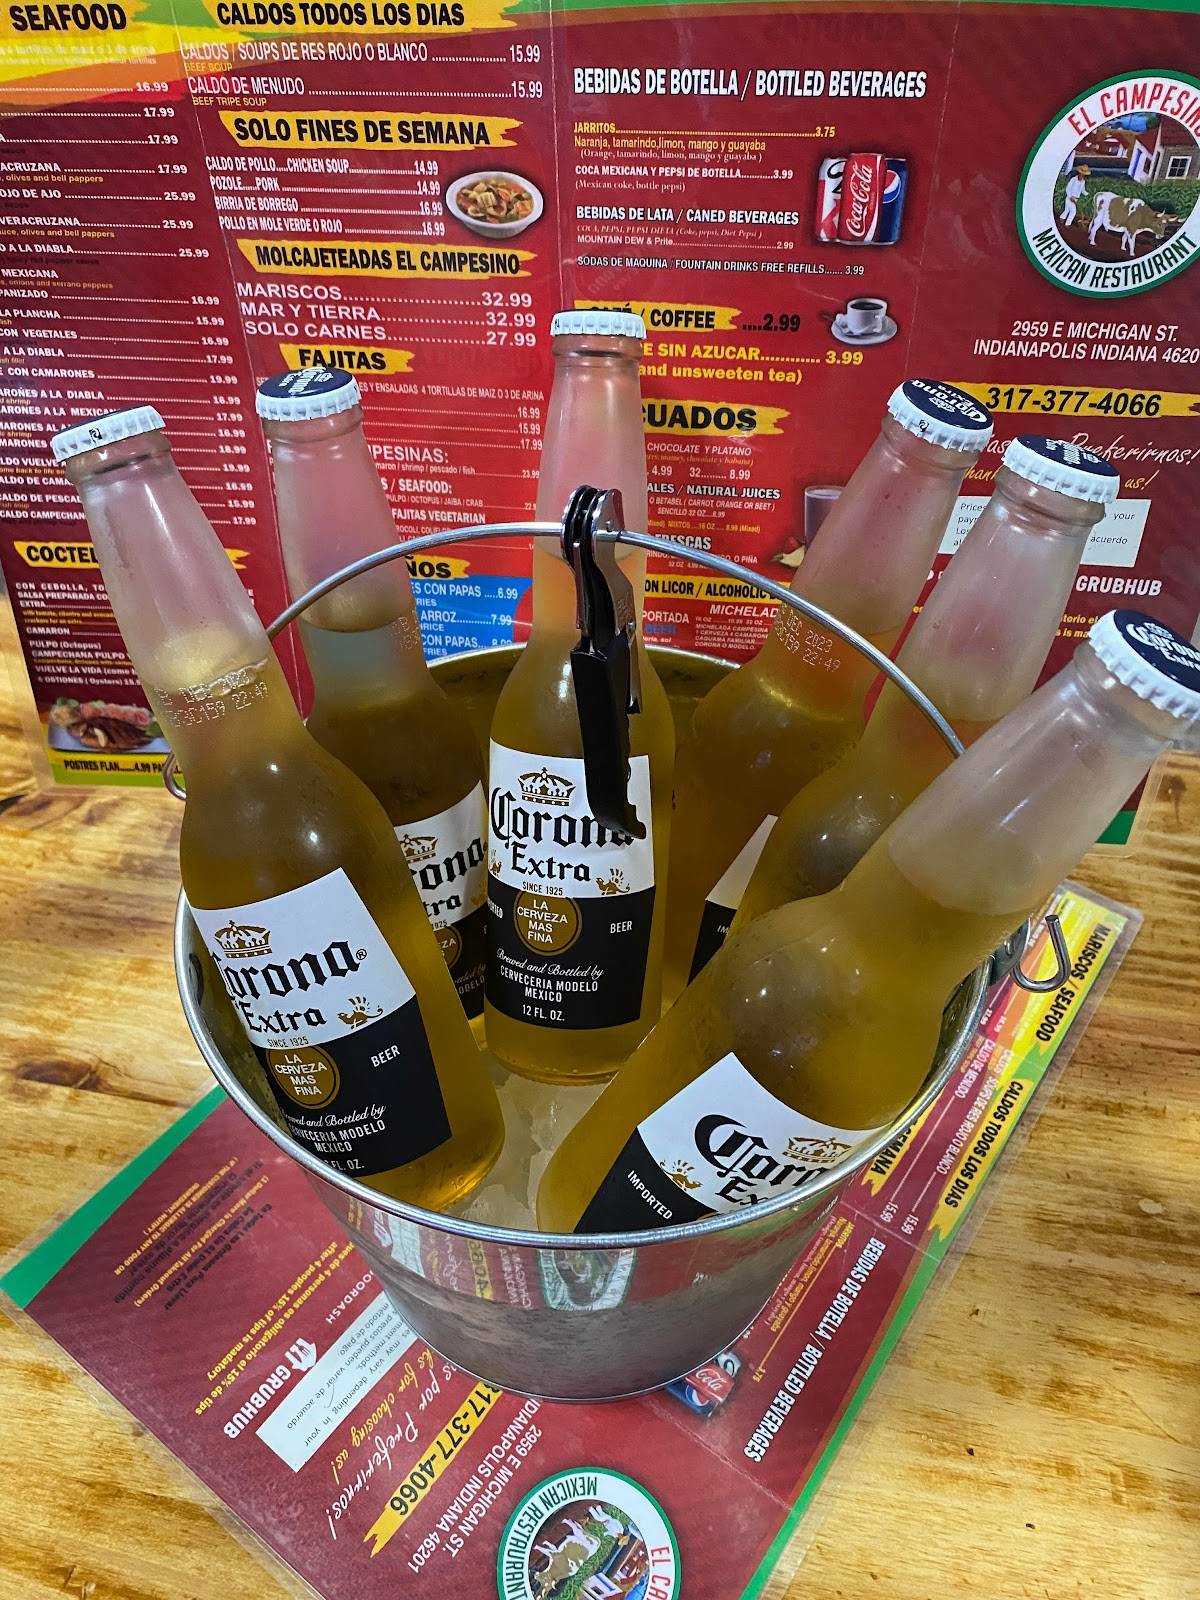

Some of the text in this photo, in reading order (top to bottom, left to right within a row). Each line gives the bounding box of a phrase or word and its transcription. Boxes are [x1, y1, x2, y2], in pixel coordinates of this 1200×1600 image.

[9, 3, 126, 31] SEAFOOD
[217, 3, 464, 26] CALDOS TODOS LOS DIAS
[181, 43, 541, 63] CALDOS SOUPS DE RES ROJO O BLANCO 15.99
[188, 76, 543, 98] CALDO DE MENUDO 15.99
[574, 68, 927, 98] BEBIDAS DE BOTELLA BOTTLED BEVERAGES
[193, 97, 267, 107] BEEF TRIPE SOUP
[234, 118, 491, 144] SOLO FINES DE SEMANA
[1068, 114, 1097, 136] EL
[688, 139, 766, 152] mango guayaba
[205, 156, 247, 171] CALDO DE
[575, 165, 700, 178] COCA MEXICANA PEPSI DE
[164, 192, 195, 201] 25.99
[214, 196, 299, 212] BIRRIA DE BORREGO
[219, 216, 342, 233] POLLO EN MOLE VERDE ROJO
[576, 206, 799, 225] BEBIDAS DE LATA CANED BEVERAGES
[577, 235, 644, 245] MOUNTAIN DEW
[179, 249, 209, 258] 25.99
[256, 245, 520, 274] MOLCAJETEADAS EL CAMPESINO
[1033, 227, 1197, 288] MEXICAN RESTAURANT
[577, 256, 864, 275] SODAS FOUNTAIN DRINKS FREE 3.99
[237, 282, 532, 308] MARISCOS 32.99
[241, 302, 536, 327] MAR Y TIERRA 32.99
[650, 308, 716, 329] COFFEE
[23, 329, 77, 339] VEGETALES
[245, 322, 536, 346] SOLO CARNES 27.99
[1012, 321, 1178, 342] 2959 E MICHIGAN ST.
[299, 349, 387, 370] FAJITAS
[658, 344, 864, 365] SIN AZUCAR 3.99
[973, 339, 1158, 362] INDIANAPOLIS INDIANA
[8, 368, 95, 379] CON CAMARONES
[672, 366, 802, 385] unsweeten tea)
[375, 383, 545, 401] ENSALADAS TORTILLAS ARINA
[986, 387, 1162, 416] 317-377-4066
[647, 443, 752, 456] CHOCOLATE PLATANO
[730, 470, 750, 480] 8.99
[399, 479, 452, 494] SEAFOOD:
[687, 484, 780, 499] NATURAL JUICES
[392, 508, 486, 524] FAJITAS VEGETARIAN
[424, 582, 482, 597] CON PAPAS
[662, 581, 694, 596] LICOR
[1076, 576, 1162, 596] GRUBHUB
[421, 611, 457, 623] ARROZ
[511, 841, 591, 882] Extra
[522, 881, 563, 896] SINCE 1925
[533, 900, 548, 910] LA
[517, 907, 568, 923] CERVEZA
[528, 920, 553, 932] MAS
[610, 920, 632, 934] BEER
[527, 930, 553, 943] FINA
[501, 965, 598, 992] CERVECERIA MODELO
[527, 963, 604, 979] and Bottled by
[1036, 924, 1111, 1042] MARISCOS SEAFOOD
[525, 987, 562, 1002] MEXICO
[523, 1005, 532, 1016] 12
[371, 1045, 400, 1068] BEER
[275, 1062, 327, 1075] CERVEZA
[315, 1141, 352, 1153] MEXICO
[945, 1081, 1023, 1208] CALDOS TODOS LOS DIAS
[627, 1170, 674, 1220] IMPORTED
[854, 1236, 886, 1284] BEBIDAS
[841, 1282, 862, 1300] DE
[815, 1292, 853, 1340] BOTELLA
[788, 1344, 822, 1396] BOTTLED
[223, 1365, 292, 1438] GRUBHUB
[351, 1391, 395, 1445] choosing
[744, 1389, 796, 1462] BEVERAGES
[460, 1424, 542, 1532] 2959 MICHIGAN
[539, 1477, 598, 1511] MEXICAN
[408, 1473, 483, 1573] INDIANA 46201
